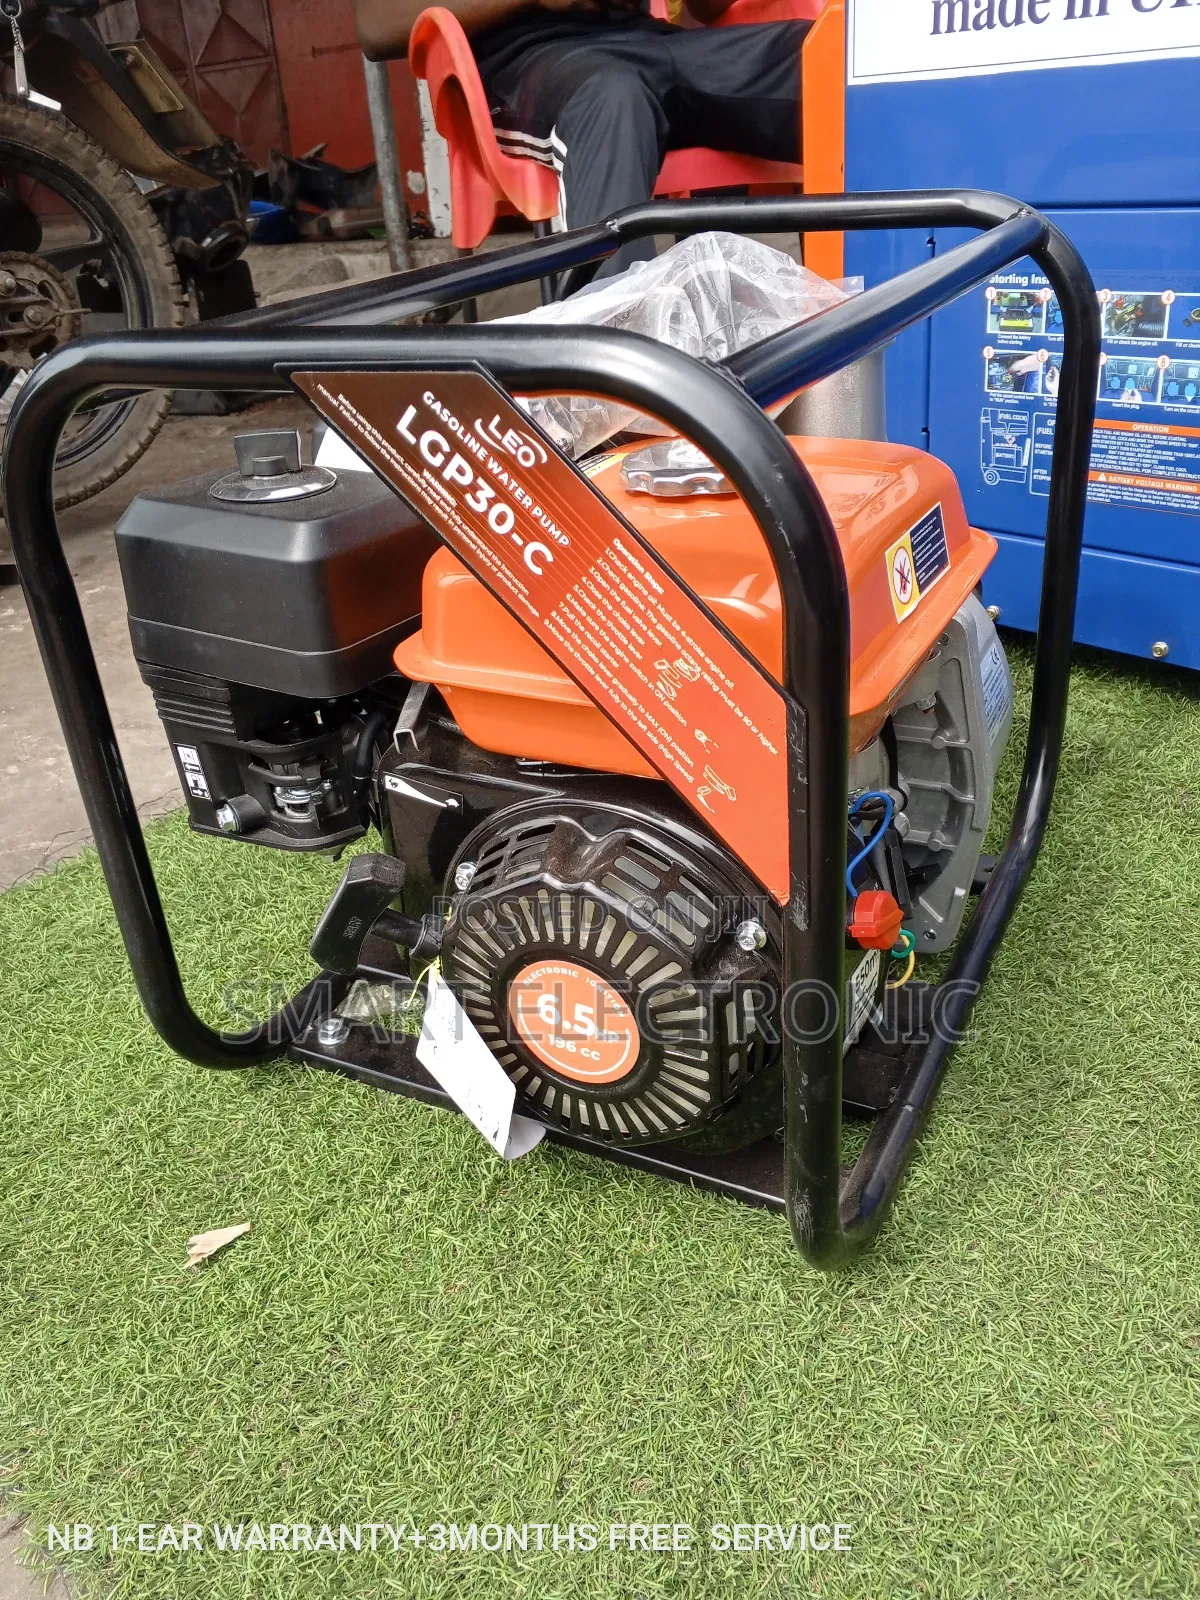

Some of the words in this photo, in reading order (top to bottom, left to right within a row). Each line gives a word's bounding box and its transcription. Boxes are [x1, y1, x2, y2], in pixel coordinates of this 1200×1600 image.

[488, 414, 536, 468] LEO
[1132, 423, 1169, 434] OPERATION
[397, 406, 553, 575] LGP30-C
[422, 468, 458, 508] WARNING:
[423, 391, 488, 461] GASOLINE
[487, 456, 533, 509] WATER
[531, 505, 570, 546] PUMP
[1109, 475, 1134, 485] BATTERY
[1136, 478, 1164, 488] VOLTAGE
[1166, 482, 1198, 492] WARNING
[613, 538, 645, 574] Operation
[643, 571, 665, 595] Steps:
[559, 601, 576, 621] 7.Pull
[574, 618, 586, 632] the
[584, 630, 602, 649] recoil
[599, 647, 620, 669] starter.
[573, 584, 597, 611] 5.Check
[595, 608, 607, 622] the
[606, 619, 629, 645] throttle
[627, 643, 643, 662] lever.
[581, 576, 603, 600] 4.Close
[601, 597, 613, 611] the
[612, 610, 631, 631] choke
[629, 628, 646, 647] lever.
[588, 566, 611, 591] 3.Open
[609, 588, 621, 603] the
[620, 600, 634, 615] fuel
[632, 613, 648, 632] valve
[646, 629, 663, 648] lever.
[605, 547, 628, 574] 1.Check
[626, 572, 649, 596] engine
[656, 603, 673, 623] Must
[671, 619, 681, 632] be
[704, 656, 726, 680] engine
[724, 679, 735, 690] oil.
[550, 610, 572, 634] 8.Move
[571, 632, 582, 645] the
[581, 644, 600, 664] choke
[598, 661, 614, 678] lever
[611, 677, 639, 706] gradually
[638, 704, 646, 714] to
[644, 711, 660, 729] MAX
[657, 726, 673, 743] (ON)
[669, 741, 694, 767] position.
[565, 593, 587, 617] 6.Make
[585, 615, 600, 631] sure
[599, 629, 610, 643] the
[609, 641, 630, 664] engine
[628, 662, 649, 684] switch
[647, 681, 655, 691] in
[654, 689, 666, 702] ON
[663, 700, 687, 727] position.
[596, 556, 621, 584] 2.Check
[645, 608, 658, 624] The
[655, 623, 682, 651] gasoline
[681, 649, 702, 675] octane
[698, 671, 720, 692] rating
[718, 690, 736, 709] must
[733, 706, 744, 718] be
[742, 715, 753, 727] 90
[750, 725, 760, 734] or
[757, 732, 778, 757] higher.
[543, 618, 565, 642] 9.Move
[563, 640, 575, 653] the
[573, 651, 596, 676] throttle
[594, 673, 609, 690] lever
[608, 688, 622, 704] fully
[620, 701, 628, 711] to
[627, 709, 638, 722] the
[636, 719, 648, 733] left
[646, 730, 659, 745] side
[657, 743, 675, 762] (High
[673, 760, 695, 784] Speed).
[522, 966, 580, 987] ELECTRONIC
[536, 993, 597, 1038] 6.5
[547, 1033, 577, 1053] 196
